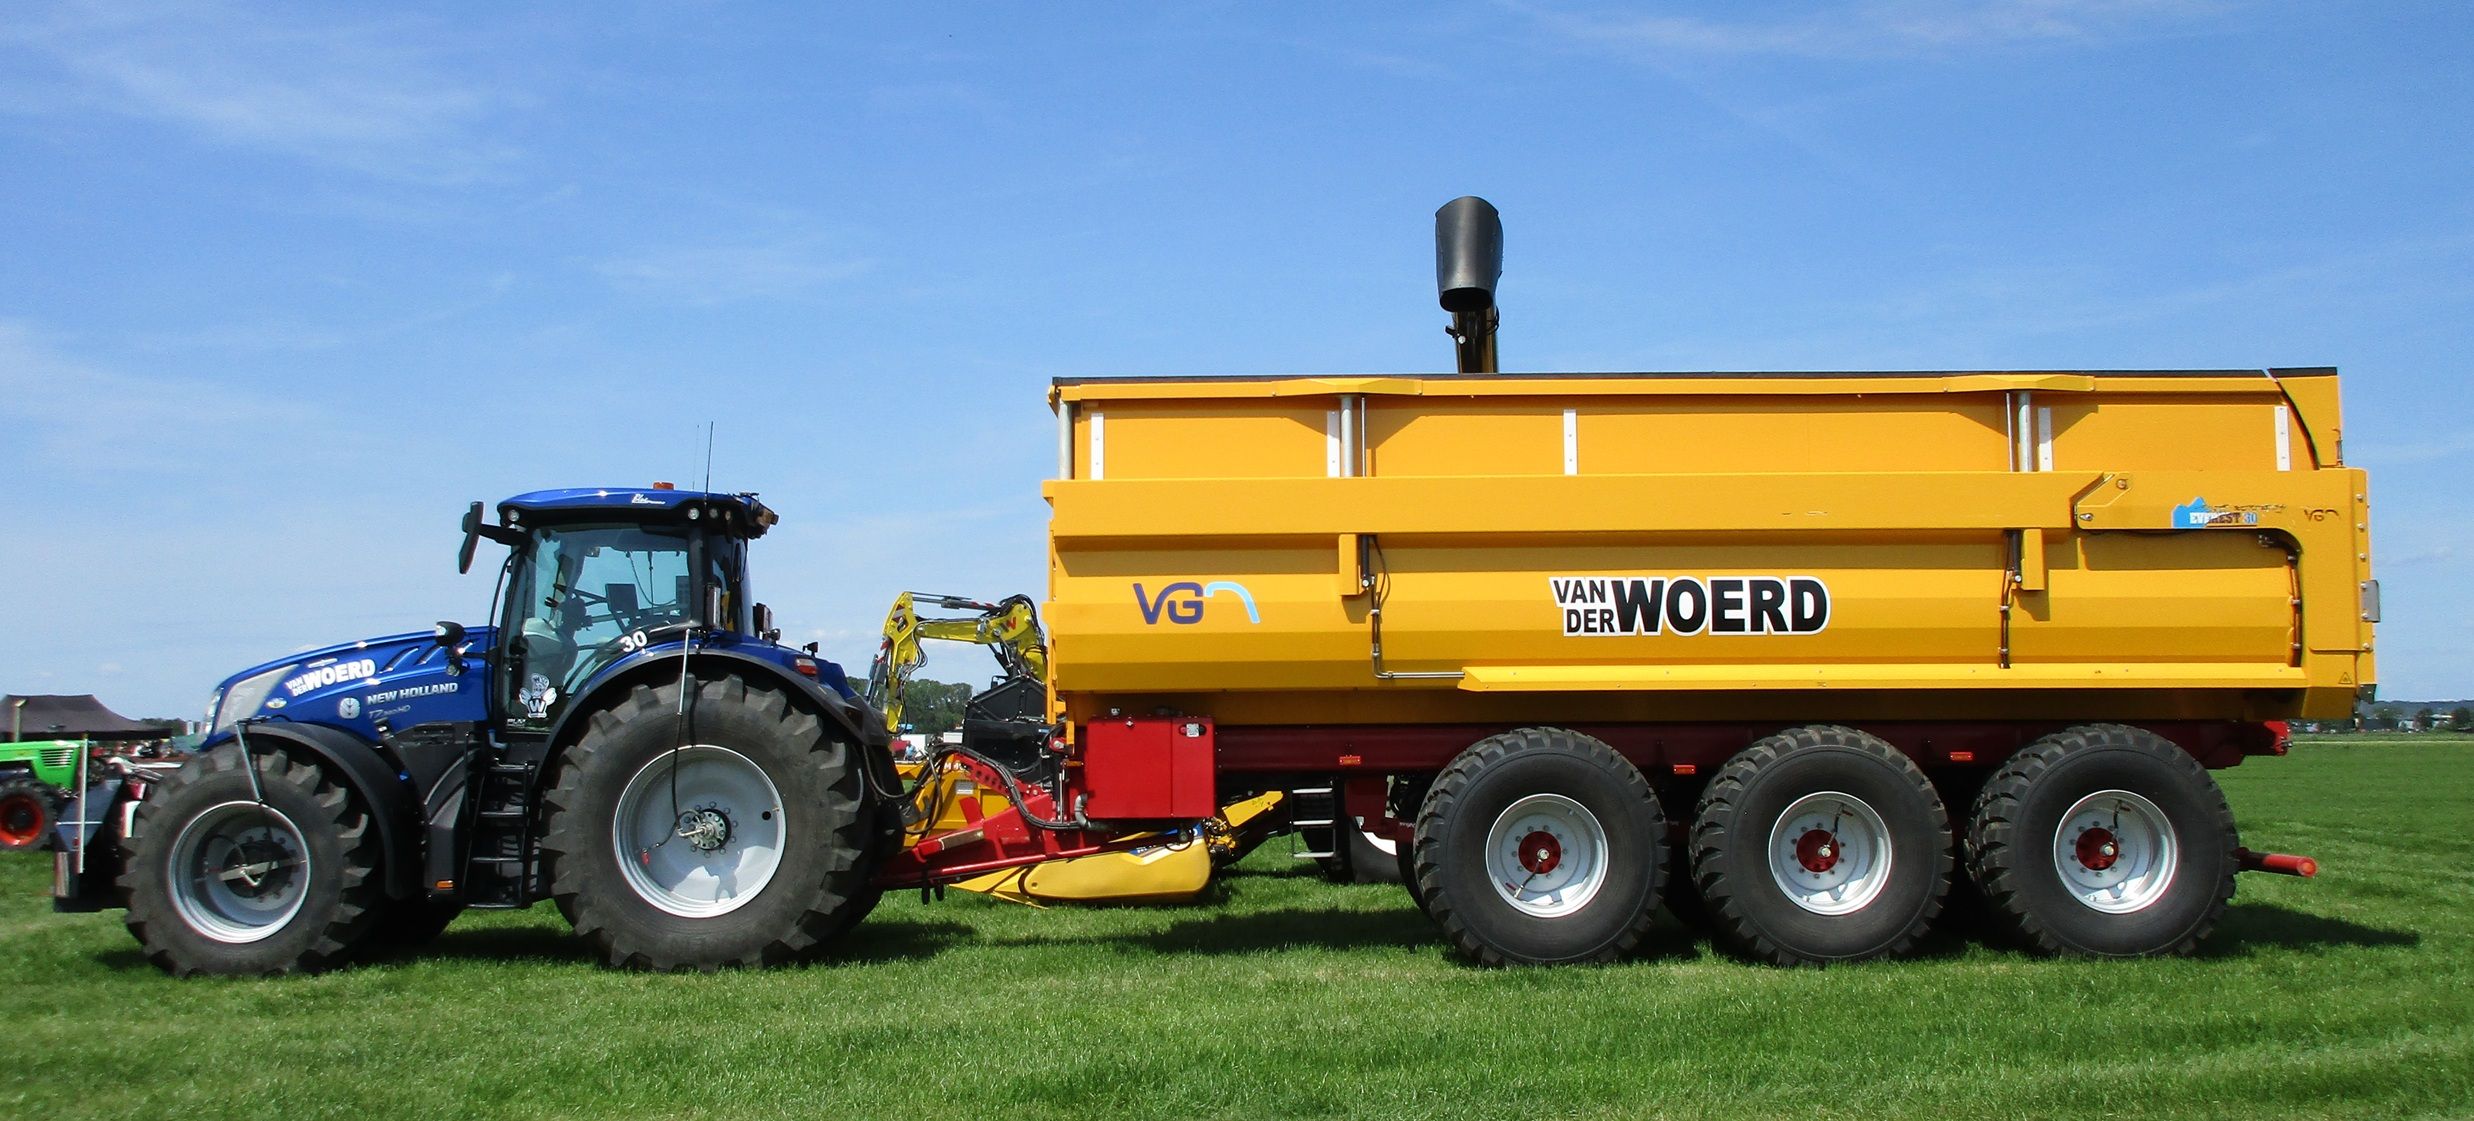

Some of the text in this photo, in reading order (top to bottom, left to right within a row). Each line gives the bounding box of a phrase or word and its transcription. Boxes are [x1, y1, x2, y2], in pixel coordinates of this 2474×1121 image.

[2190, 512, 2240, 524] EVEREST
[1553, 580, 1606, 604] VAN
[1611, 578, 1828, 634] WOERD
[1566, 609, 1616, 633] DER
[620, 630, 648, 653] 30
[285, 676, 304, 690] VAN
[302, 658, 376, 692] WOERD
[291, 684, 310, 697] DER
[366, 682, 459, 705] NEW HOLLAND
[529, 699, 546, 713] W
